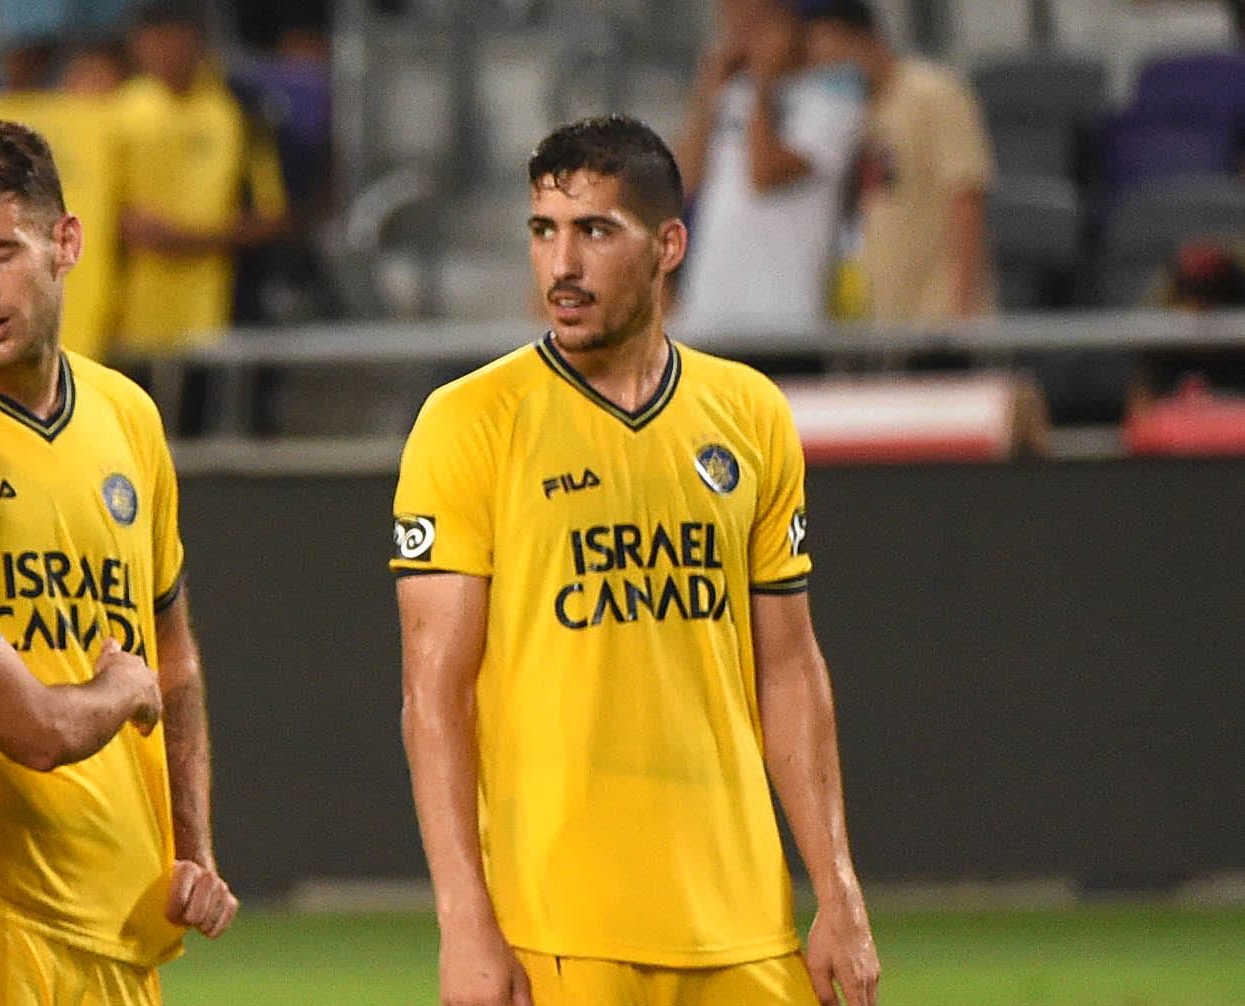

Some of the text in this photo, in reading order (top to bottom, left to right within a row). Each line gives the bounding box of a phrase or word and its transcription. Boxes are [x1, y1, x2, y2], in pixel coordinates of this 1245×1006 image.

[542, 468, 601, 500] FILA
[571, 521, 723, 576] ISRAEL
[2, 551, 137, 610] ISRAEL
